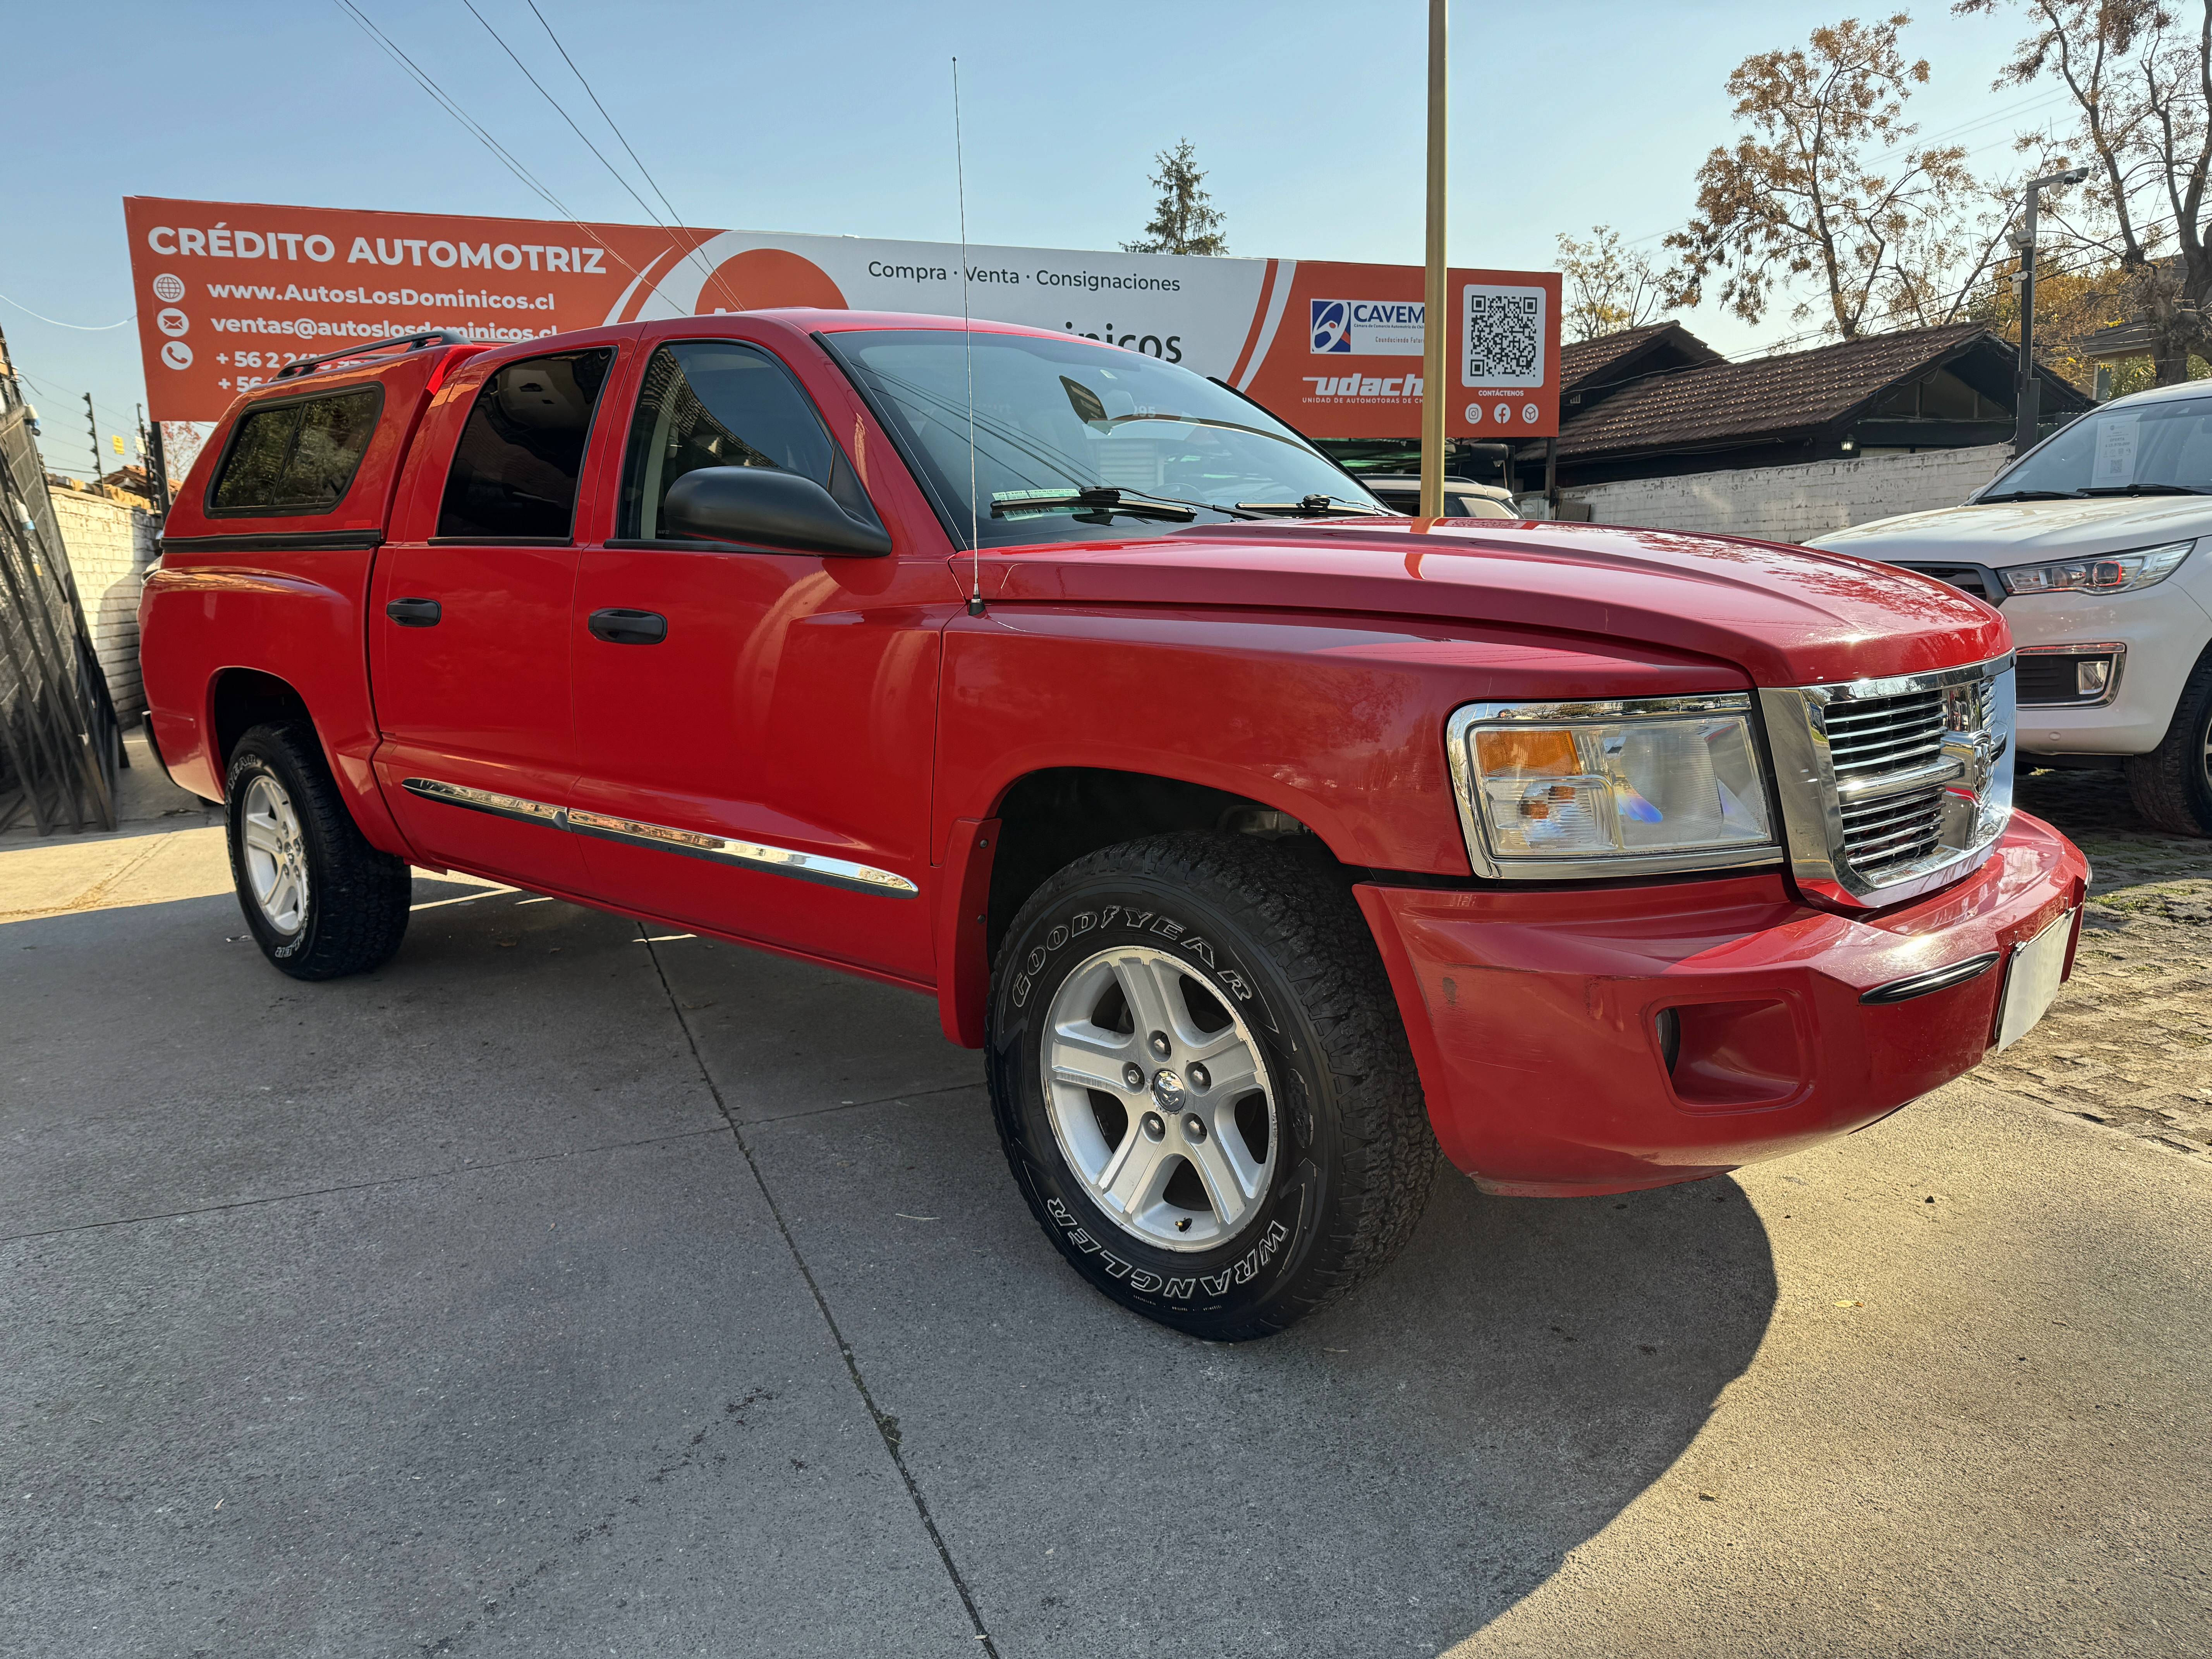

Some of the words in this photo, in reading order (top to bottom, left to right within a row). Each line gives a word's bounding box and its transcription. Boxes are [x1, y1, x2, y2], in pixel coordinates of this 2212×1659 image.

[148, 222, 335, 262] CRÉDITO
[347, 237, 606, 274] AUTOMOTRIZ
[868, 261, 947, 283] Compra
[965, 266, 1019, 284] Venta
[1036, 269, 1180, 292] Consignaciones
[206, 283, 554, 310] www.AutosLosDominicos.cl
[210, 317, 557, 339] ventas@autoslosdminicos.cl
[1353, 304, 1425, 323] CAVEM
[234, 351, 262, 368] 56
[265, 352, 280, 368] 2
[1012, 905, 1252, 1008] GOODYEAR
[1047, 1197, 1289, 1299] WRANGLER
